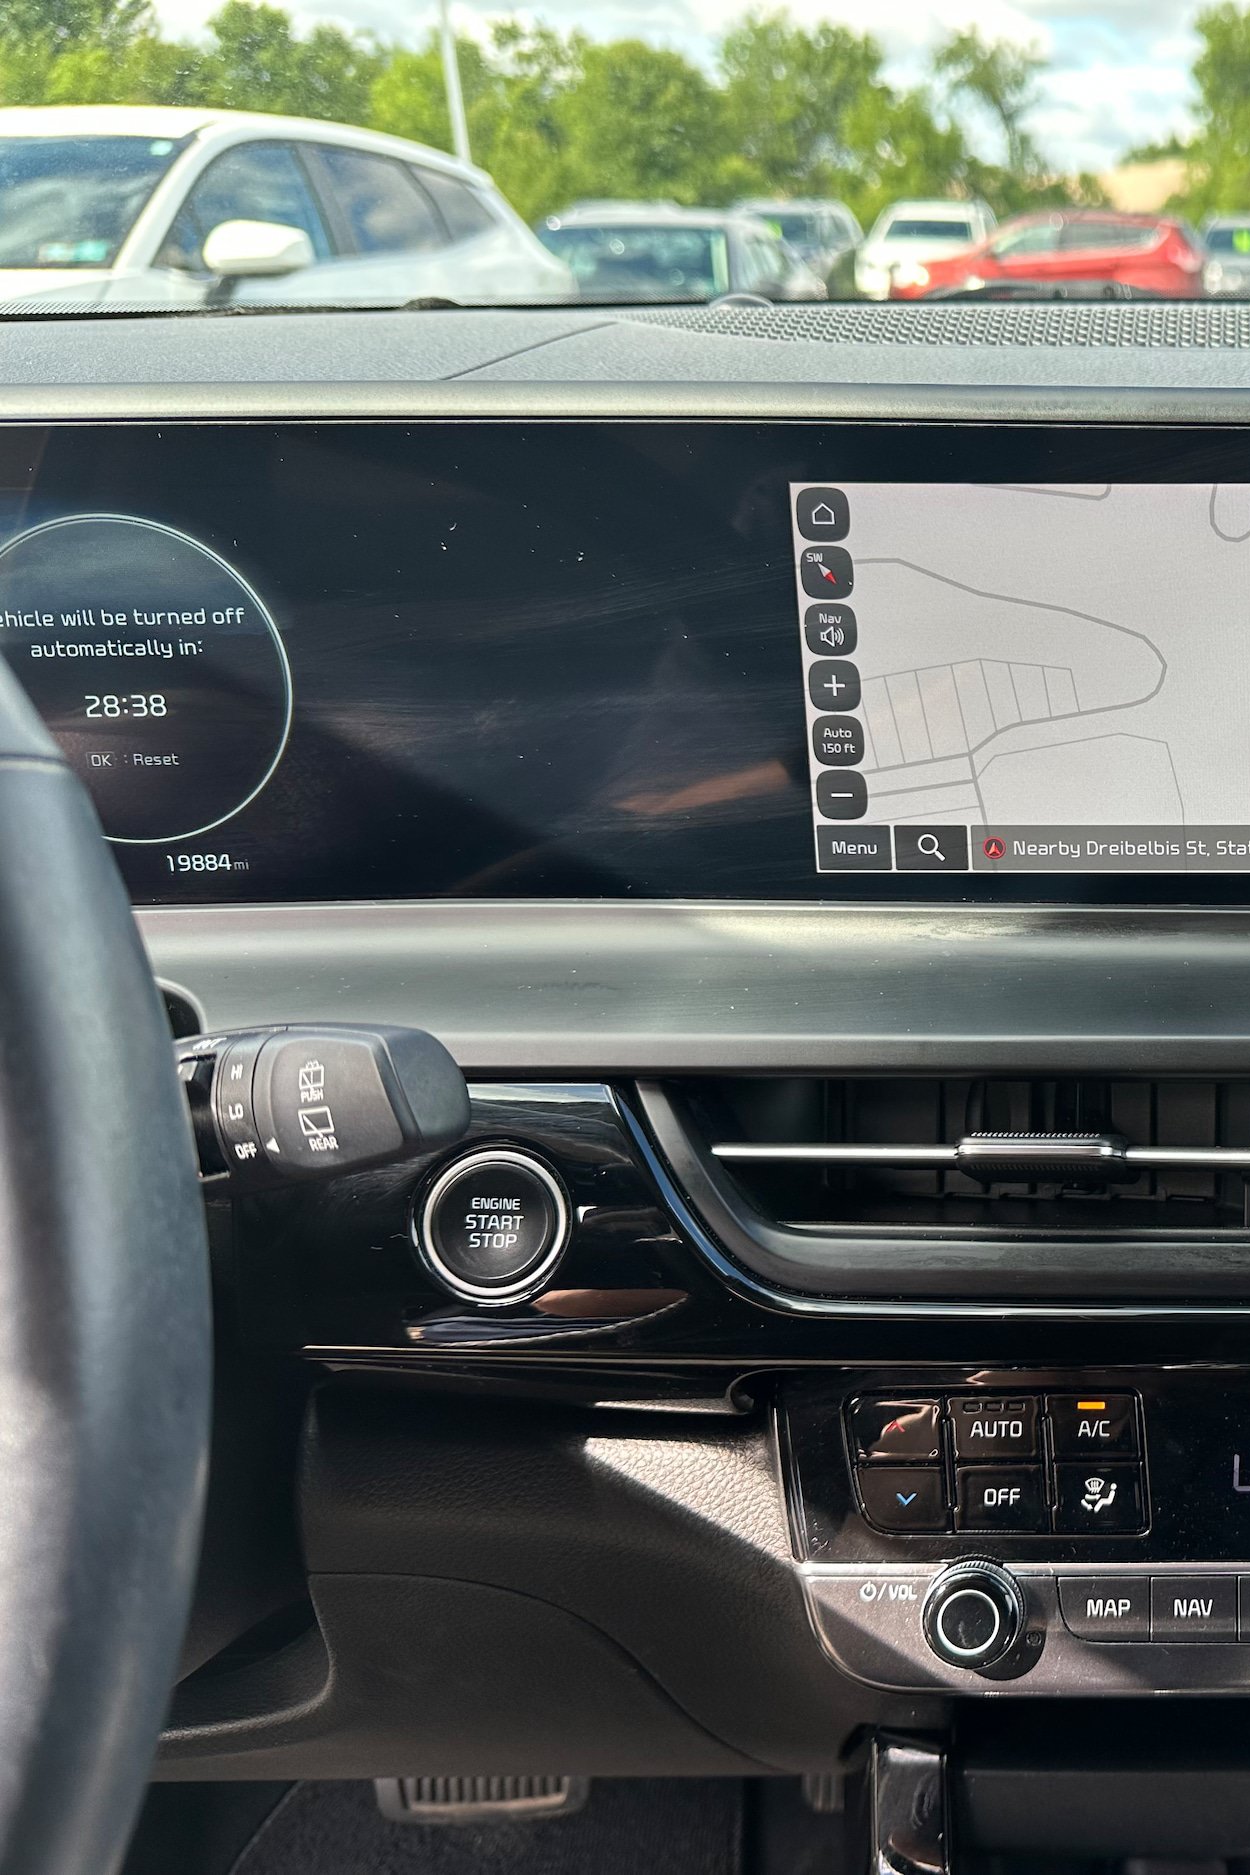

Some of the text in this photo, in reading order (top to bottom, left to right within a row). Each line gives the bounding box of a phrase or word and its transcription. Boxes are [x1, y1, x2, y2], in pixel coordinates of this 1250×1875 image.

[806, 552, 823, 563] SW
[0, 607, 245, 627] hicle will be turned off
[819, 613, 842, 625] Nav
[31, 639, 203, 659] automatically in:
[85, 694, 167, 717] 28:38
[823, 727, 852, 738] Auto
[822, 743, 856, 754] 150 ft
[91, 754, 112, 767] OK
[133, 753, 180, 766] Reset
[832, 840, 878, 855] Menu
[1013, 840, 1081, 858] Nearby
[1086, 840, 1181, 856] Dreibelbis
[1186, 840, 1210, 857] St,
[167, 854, 232, 872] 19884
[230, 1063, 244, 1081] HI
[301, 1089, 324, 1103] PUSH
[228, 1103, 244, 1120] LO
[234, 1142, 257, 1160] OFF
[309, 1136, 339, 1152] REAR
[471, 1197, 521, 1210] ENGINE
[465, 1214, 524, 1230] START
[468, 1233, 517, 1248] STOP
[970, 1420, 1023, 1438] AUTO
[1077, 1420, 1111, 1438] A/C
[984, 1488, 1021, 1506] OFF
[1086, 1599, 1131, 1617] MAP
[1174, 1599, 1213, 1617] NAV
